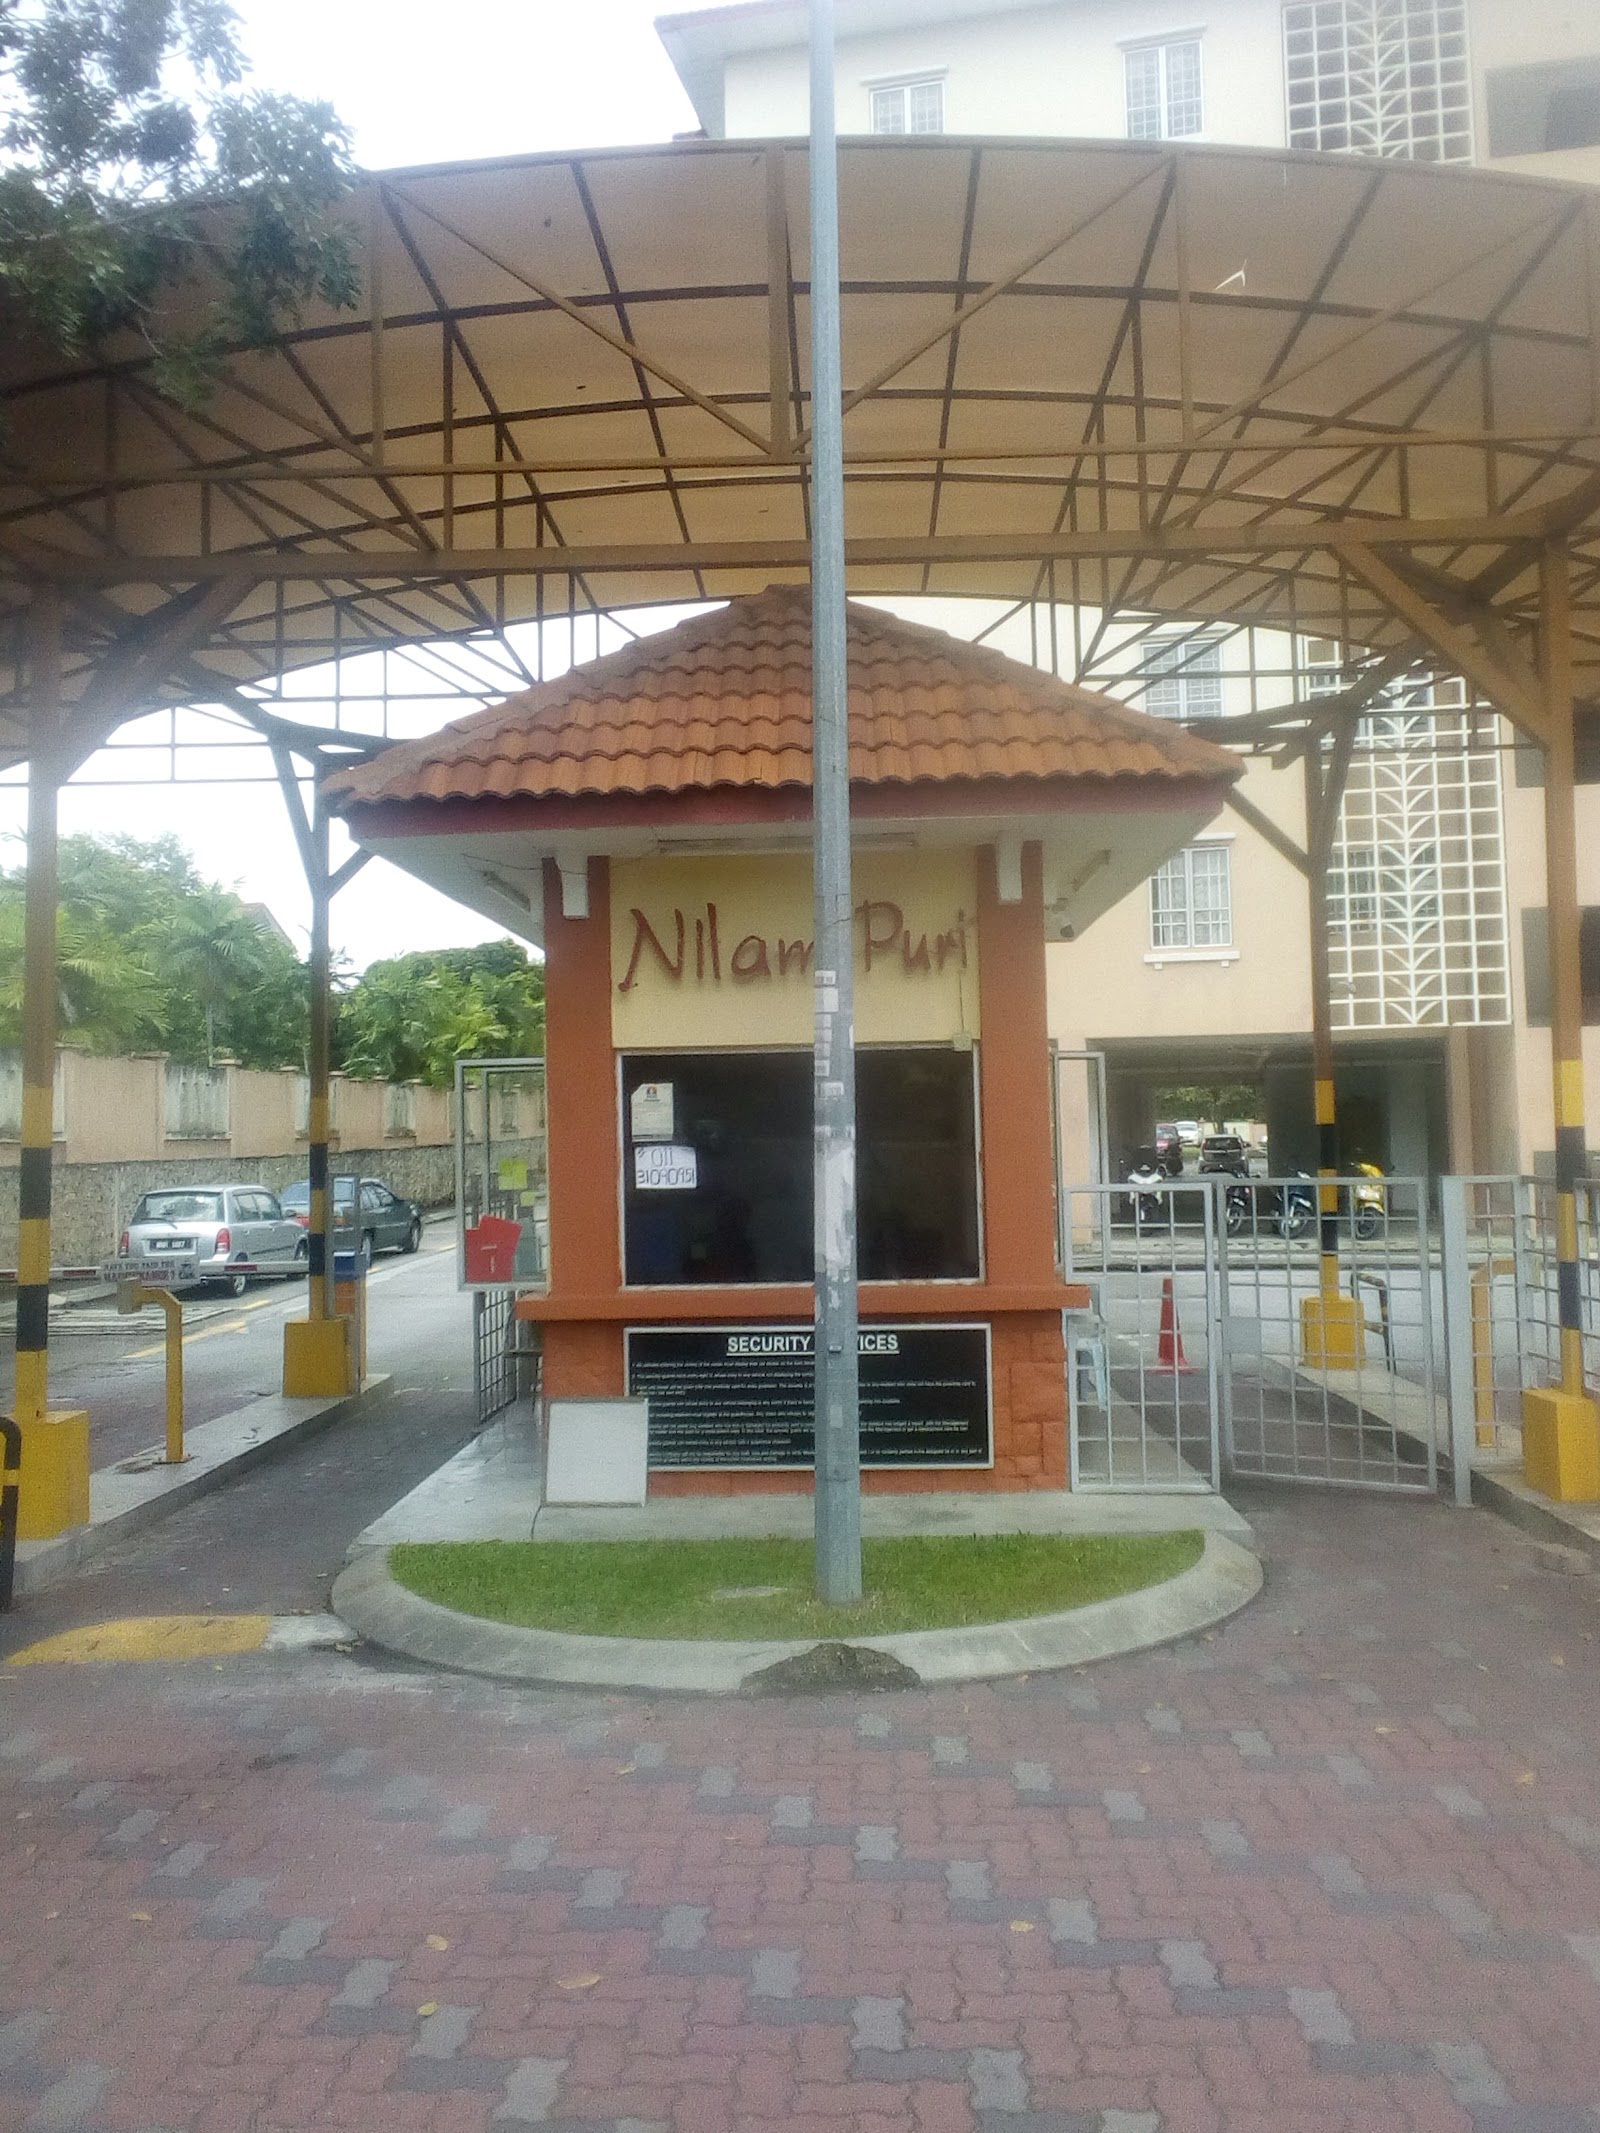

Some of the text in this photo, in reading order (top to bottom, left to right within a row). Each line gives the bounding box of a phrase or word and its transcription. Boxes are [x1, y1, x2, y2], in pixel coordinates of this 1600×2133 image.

[855, 899, 968, 974] Puri
[727, 1334, 899, 1352] SECURITY ICES
